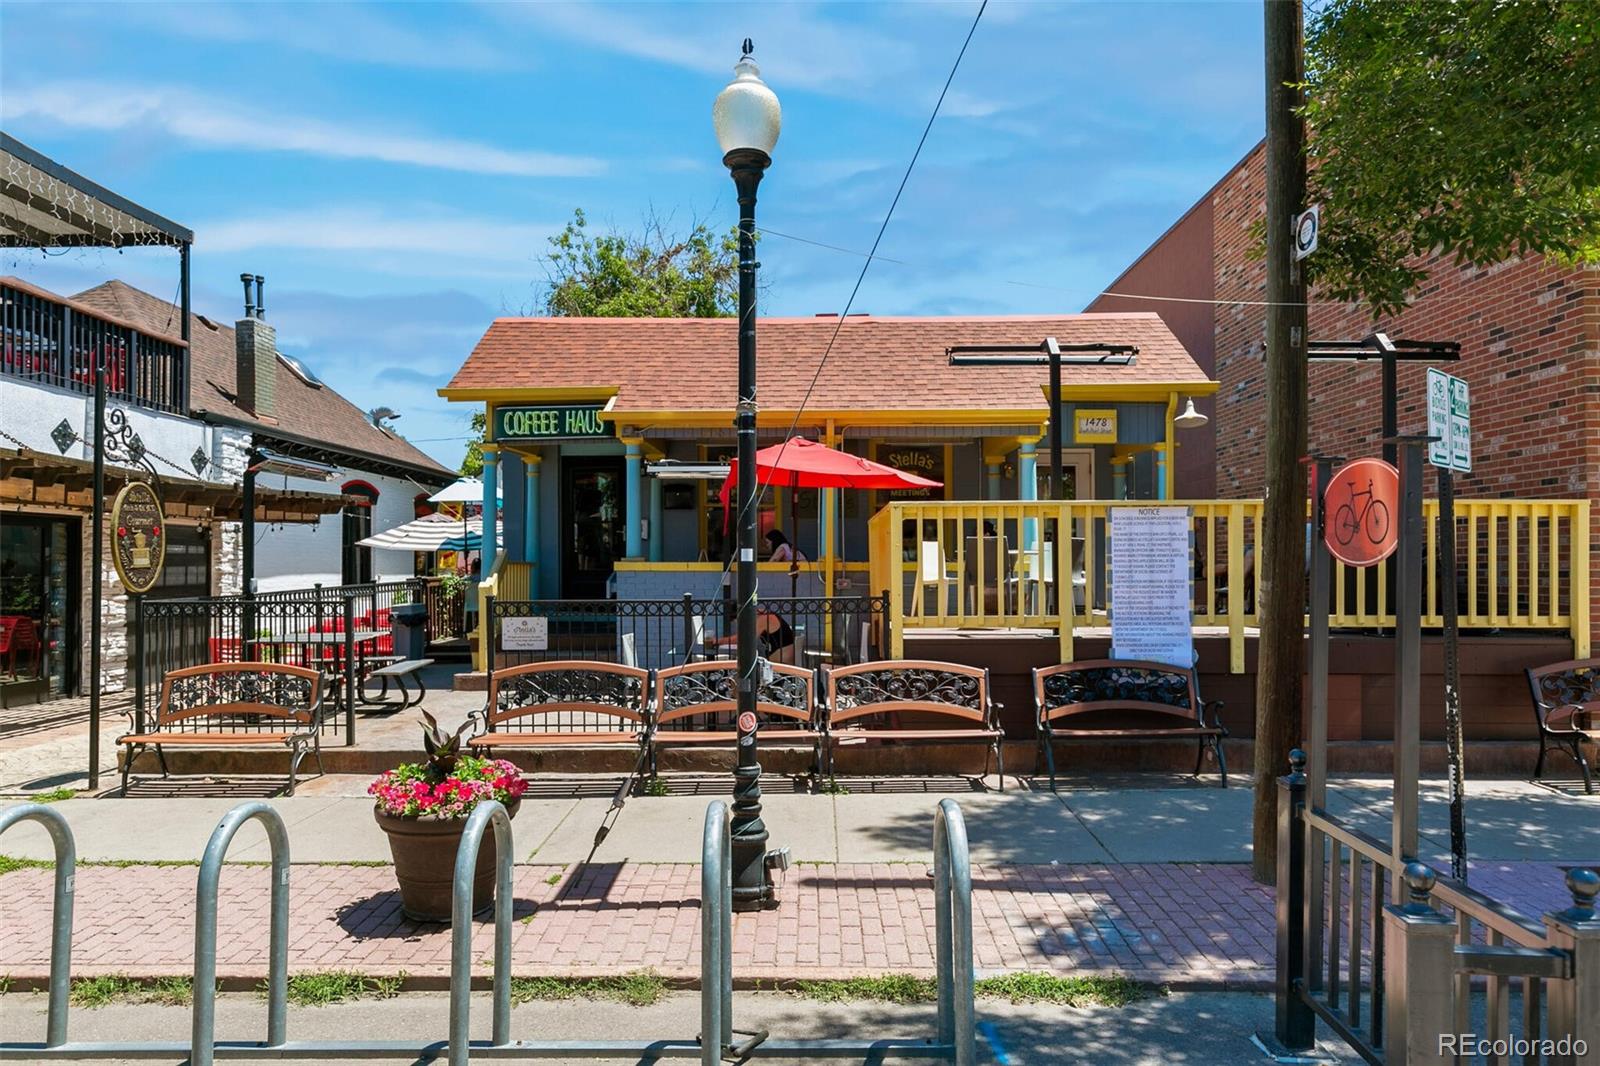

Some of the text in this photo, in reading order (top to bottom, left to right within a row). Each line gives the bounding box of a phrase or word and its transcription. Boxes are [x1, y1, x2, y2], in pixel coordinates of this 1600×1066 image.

[503, 409, 605, 435] COFFEE HAUS
[1085, 417, 1107, 427] 1478
[889, 452, 935, 470] Stella's
[1138, 508, 1161, 516] NOTICE
